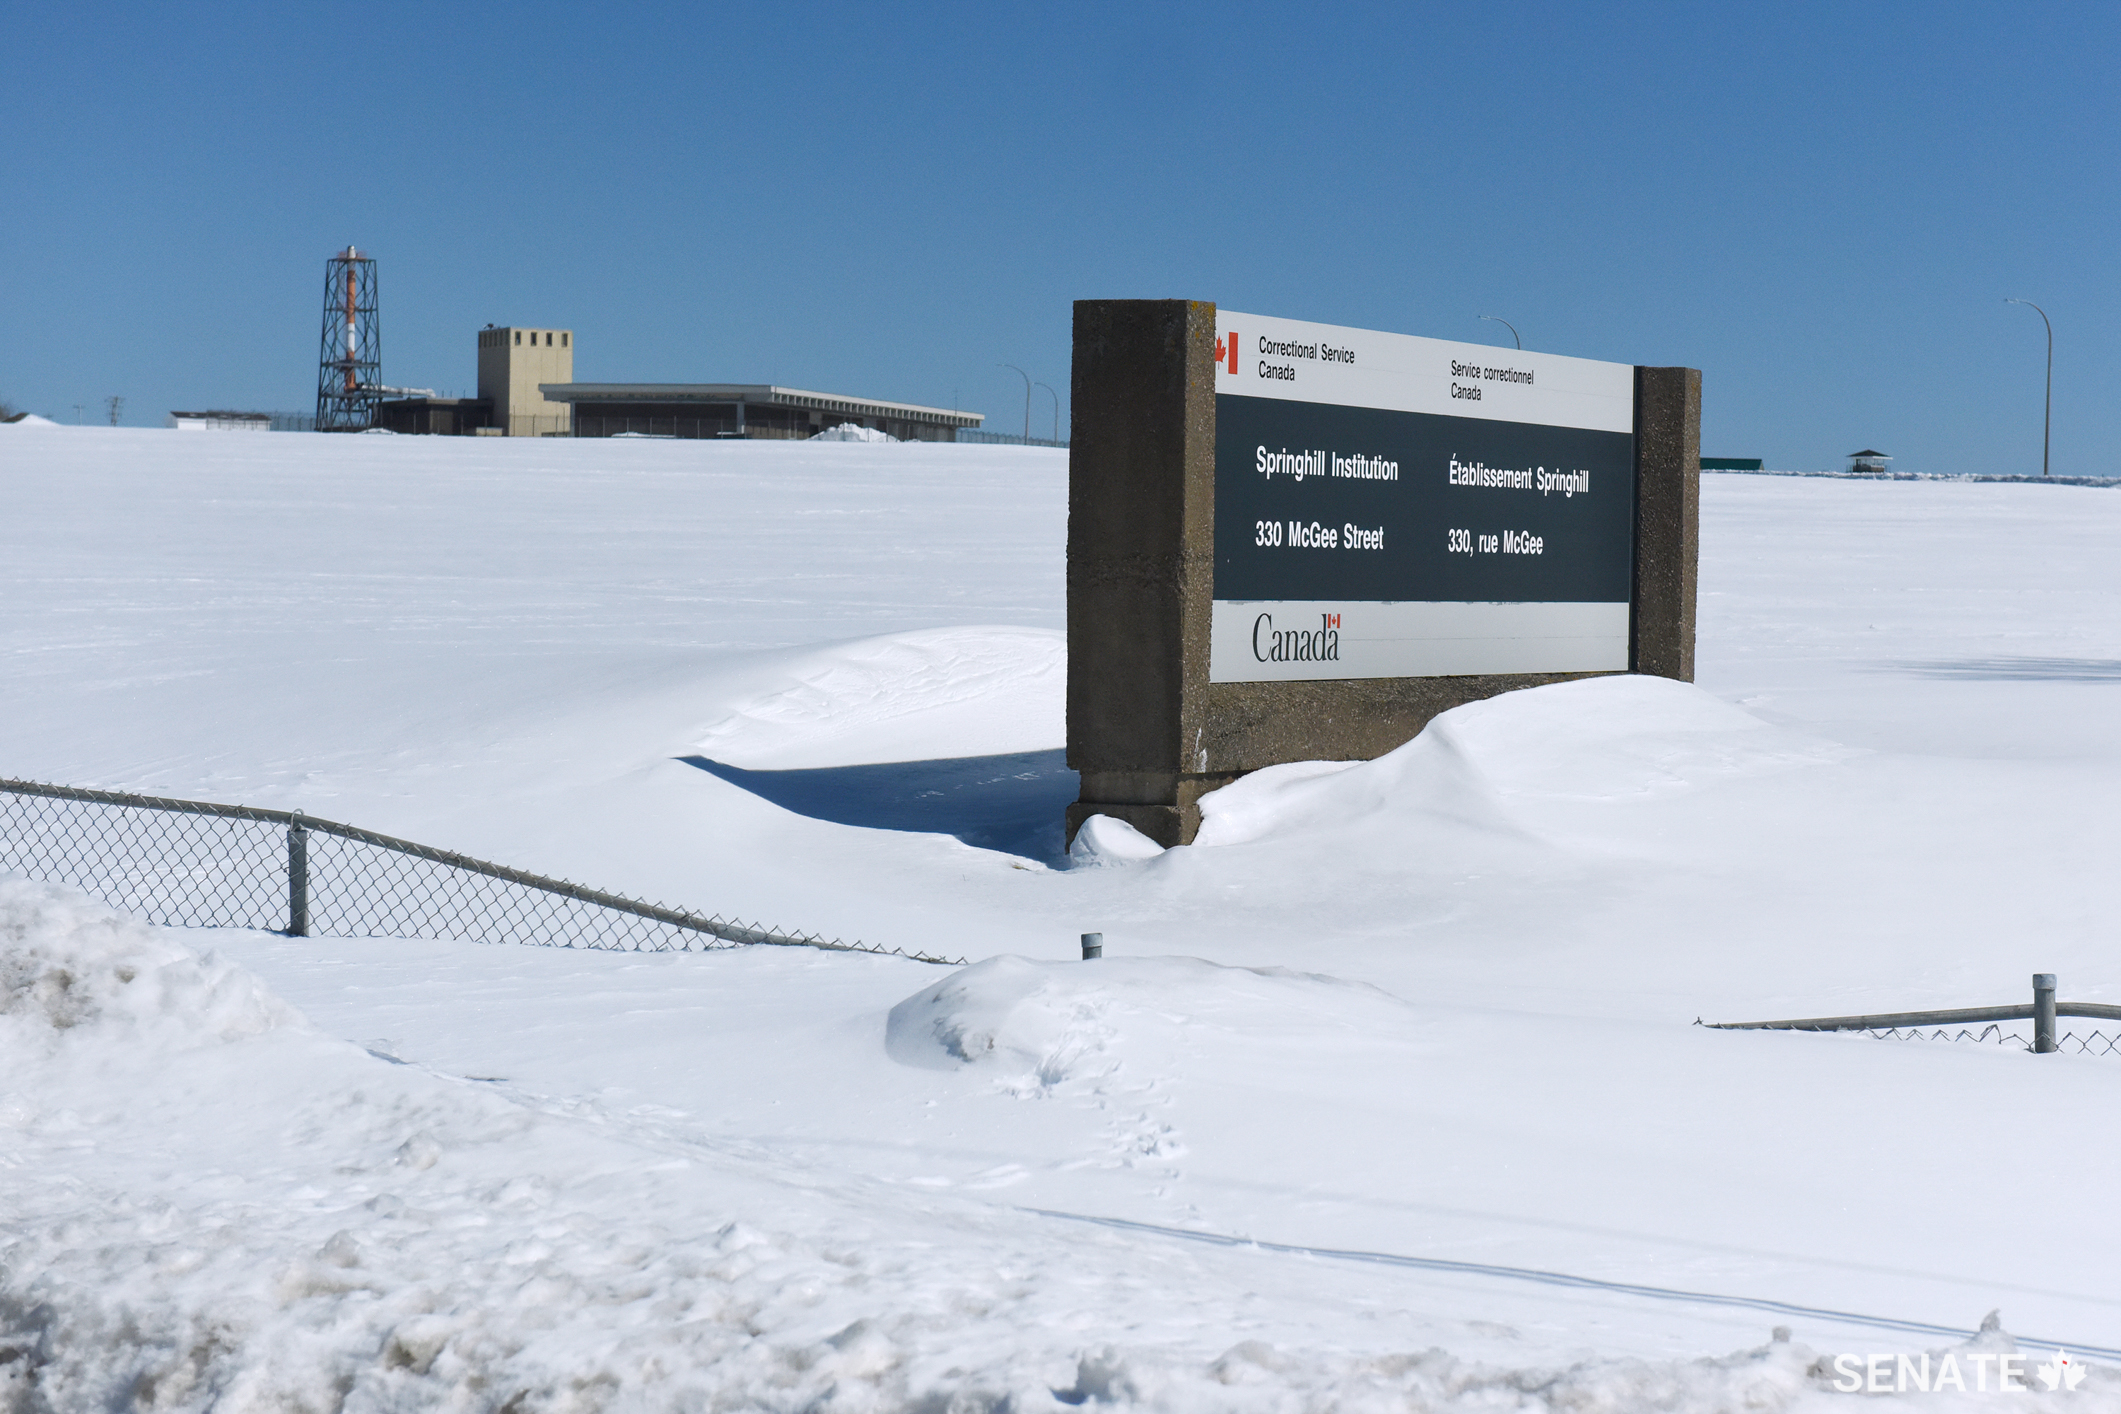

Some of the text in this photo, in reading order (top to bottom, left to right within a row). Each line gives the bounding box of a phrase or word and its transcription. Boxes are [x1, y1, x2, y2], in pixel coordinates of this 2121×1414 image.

[1258, 336, 1354, 363] Correctional Service
[1258, 360, 1296, 382] Canada
[1451, 360, 1533, 384] Service correctionnel
[1451, 382, 1481, 400] Canada
[1256, 446, 1398, 481] Springhill Institution
[1450, 453, 1588, 497] Établissement Springhill
[1256, 521, 1383, 549] 330 McGee Street
[1448, 529, 1543, 557] 330, rue McGee
[1253, 613, 1340, 662] Canada
